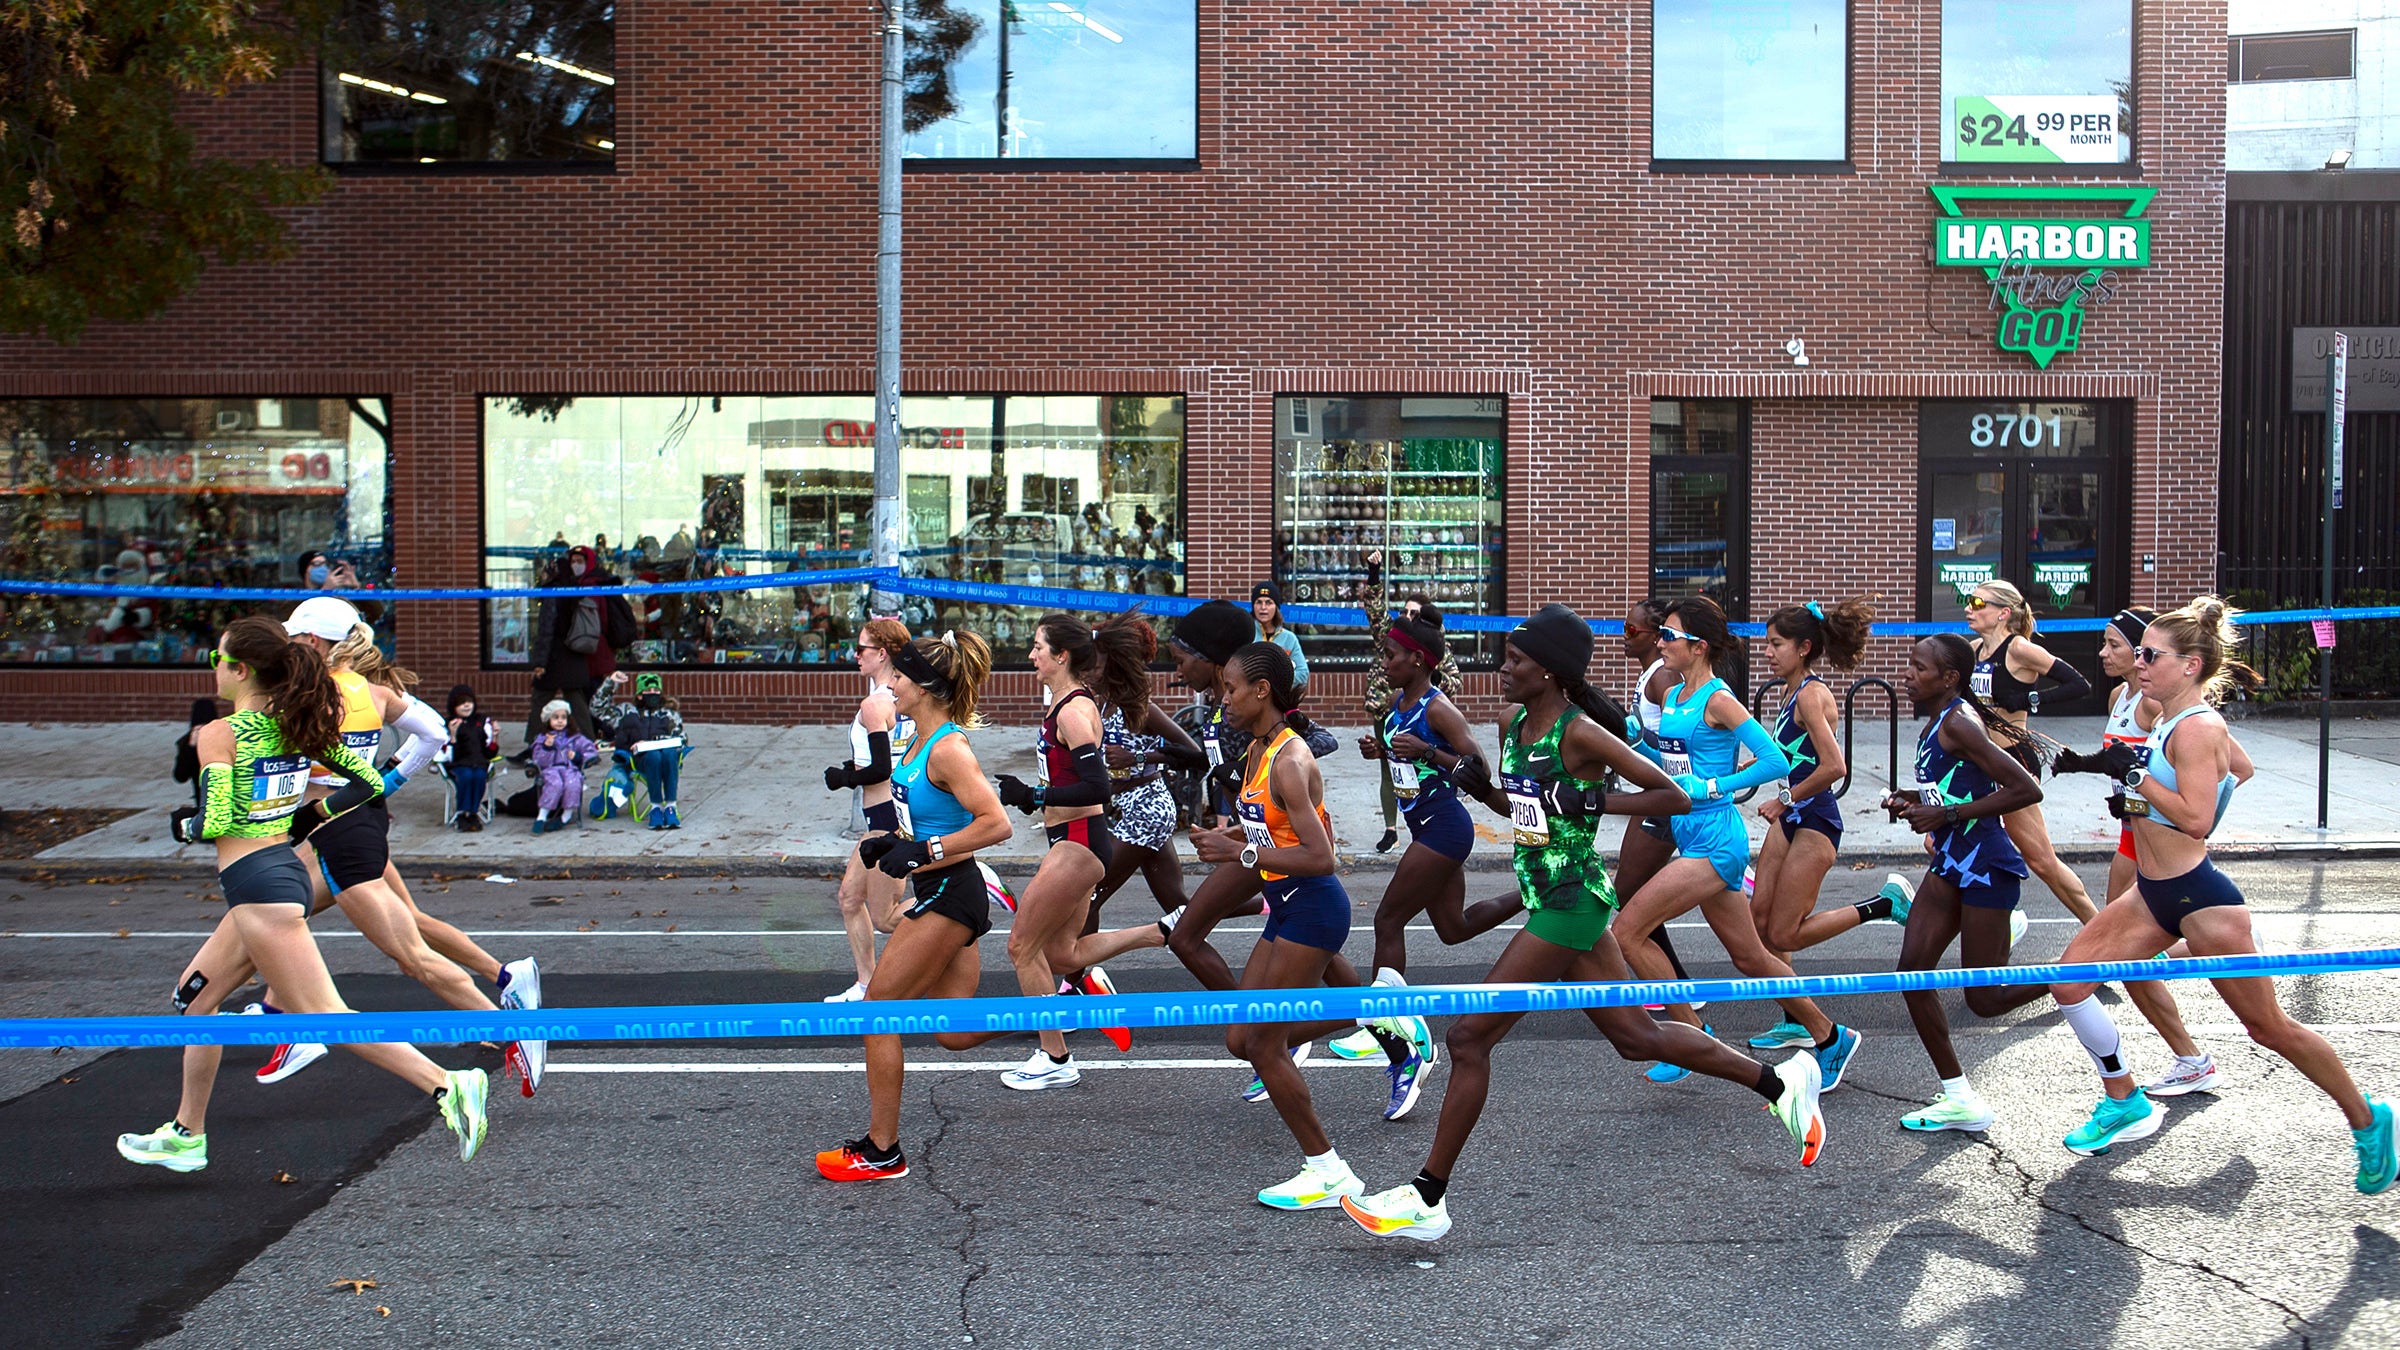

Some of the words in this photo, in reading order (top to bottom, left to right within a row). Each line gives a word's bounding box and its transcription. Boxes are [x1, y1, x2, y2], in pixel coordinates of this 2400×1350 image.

[2070, 114, 2111, 132] PER
[2070, 134, 2111, 144] MONTH
[1947, 224, 2140, 260] HARBOR
[1987, 249, 2122, 311] fitness
[2002, 312, 2082, 347] GO!
[1970, 413, 2062, 447] 8701
[1941, 571, 1993, 582] HARBOR
[2035, 571, 2088, 582] HARBOR
[907, 580, 932, 591] POLICE
[934, 583, 949, 594] LINE
[967, 585, 982, 596] NOT
[983, 586, 1008, 599] CROSS
[1017, 589, 1042, 601] POLICE
[1043, 591, 1060, 603] LINE
[1066, 593, 1077, 604] DO
[1078, 593, 1094, 606] NOT
[1094, 595, 1118, 608] CROSS
[1154, 599, 1171, 611] LINE
[1177, 601, 1188, 613] DO
[1288, 610, 1300, 620] DO
[1300, 611, 1315, 621] NOT
[1316, 611, 1341, 622] CROSS
[1462, 620, 1487, 630] POLICE
[1489, 621, 1505, 630] LINE
[1600, 625, 1615, 634] LINE
[263, 761, 279, 773] tcs
[277, 774, 296, 797] 106
[986, 1010, 1067, 1031] POLICE
[1077, 1007, 1126, 1028] LINE
[1154, 1005, 1184, 1026] DO
[1193, 1004, 1239, 1025] NOT
[1247, 1000, 1324, 1022] CROSS
[1361, 995, 1441, 1018] POLICE
[1450, 991, 1500, 1014] LINE
